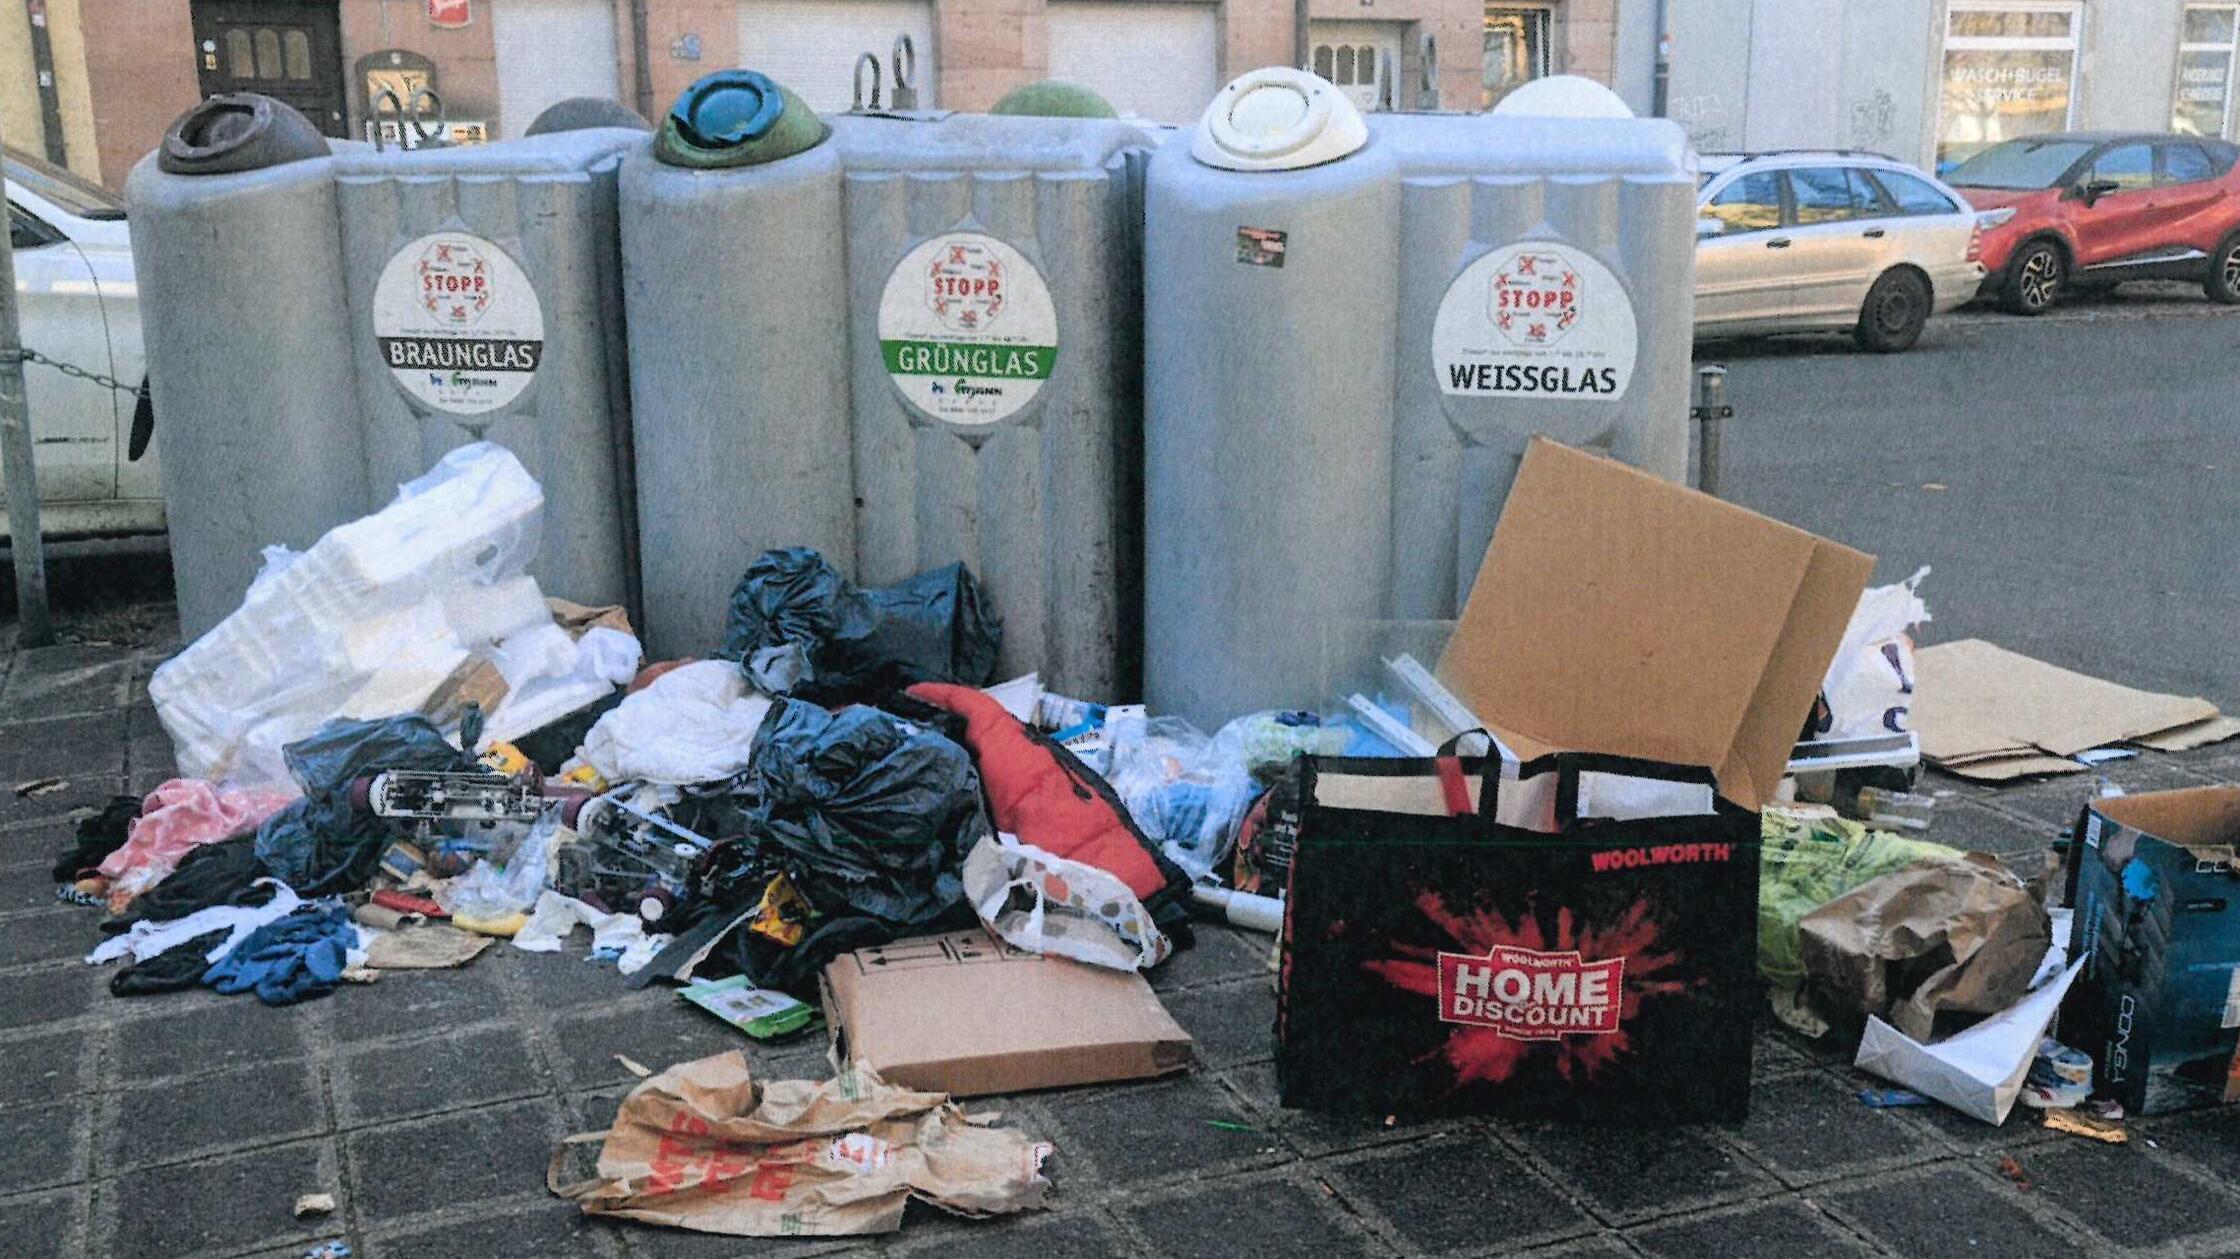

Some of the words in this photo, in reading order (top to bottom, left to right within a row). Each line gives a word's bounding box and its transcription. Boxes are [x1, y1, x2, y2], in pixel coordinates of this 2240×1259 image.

[424, 275, 485, 292] STOPP
[934, 278, 999, 296] STOPP
[1498, 290, 1574, 309] STOPP
[389, 341, 534, 369] BRAUNGLAS
[899, 345, 1040, 376] GRÜNGLAS
[1449, 363, 1617, 394] WEISSGLAS
[1590, 843, 1731, 872] WOOLWORTH
[1454, 962, 1611, 1006] HOME
[1453, 996, 1608, 1027] DISCOUNT
